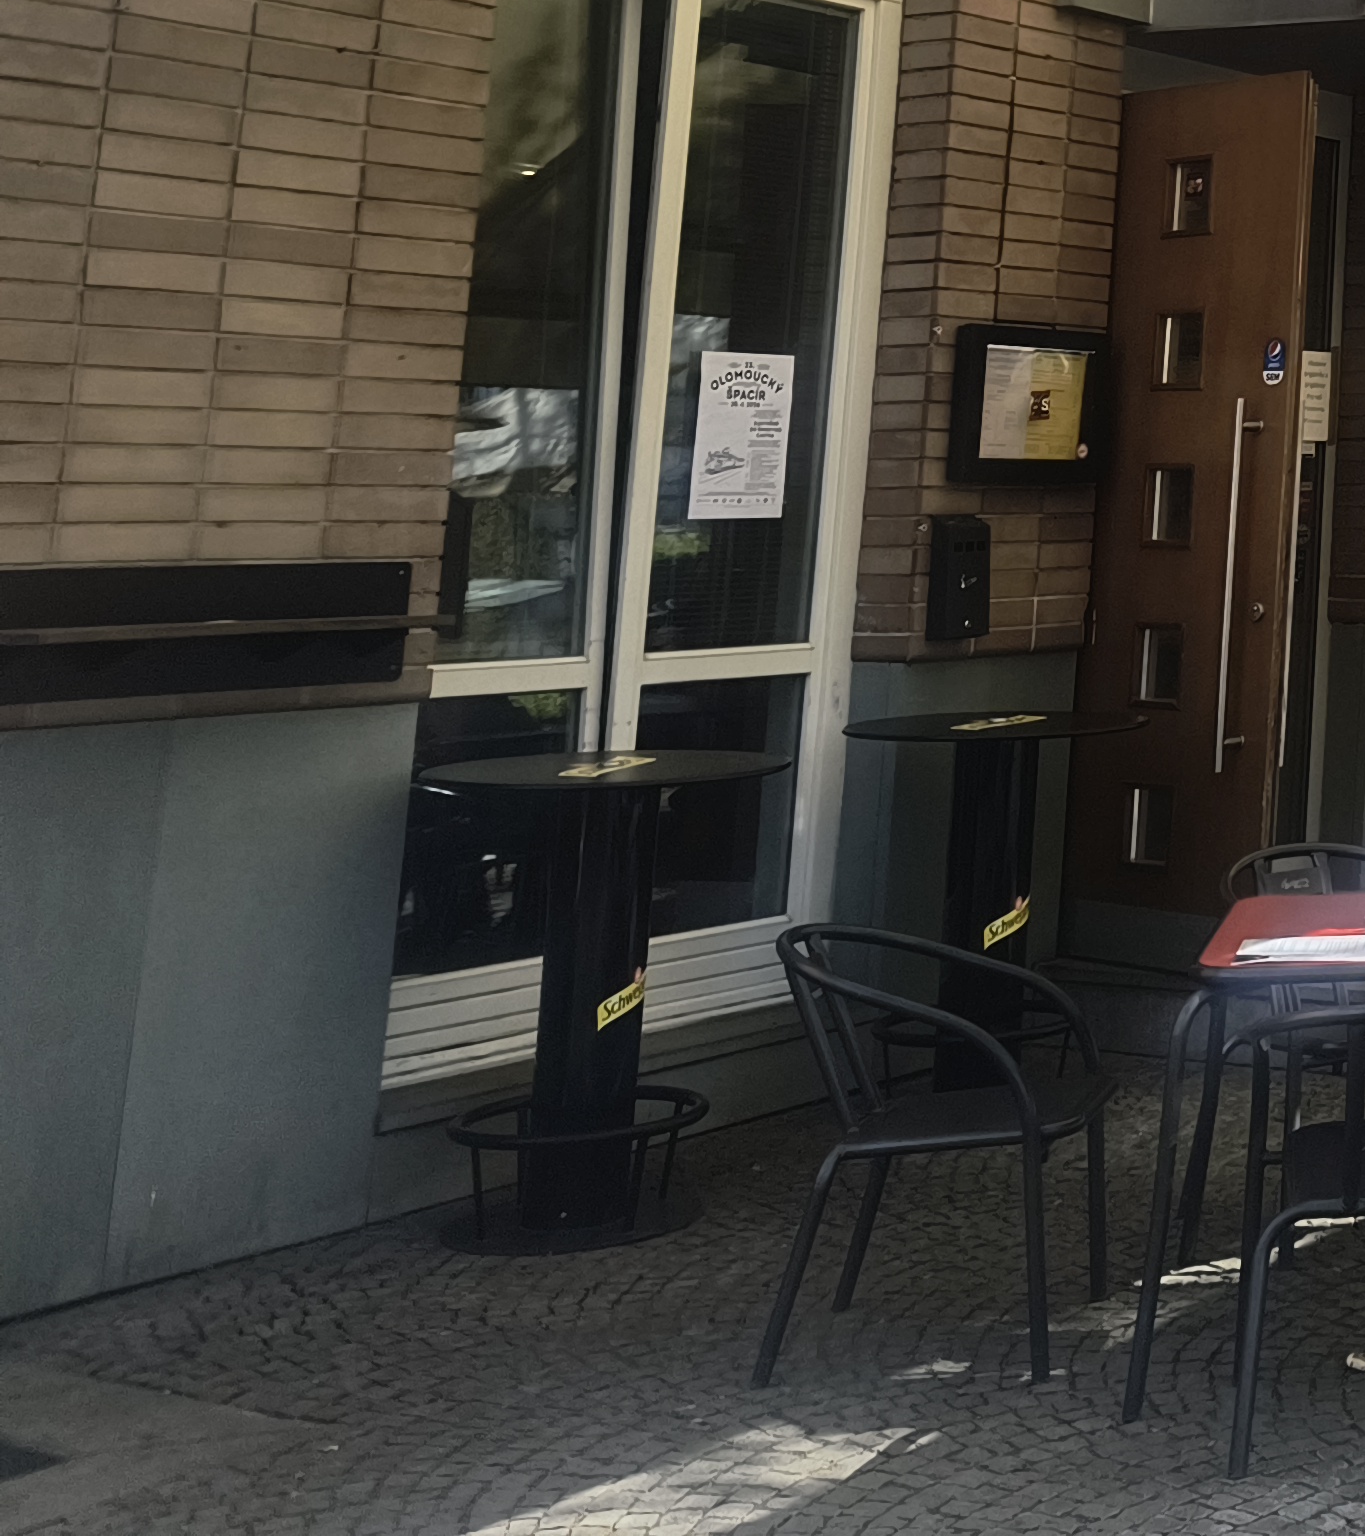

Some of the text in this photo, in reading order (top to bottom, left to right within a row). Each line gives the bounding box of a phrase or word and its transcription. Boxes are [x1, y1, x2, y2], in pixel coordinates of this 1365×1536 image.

[710, 369, 785, 394] OLOMOUCKÝ
[1265, 372, 1281, 382] SEM
[726, 385, 766, 401] ŠPACÍR
